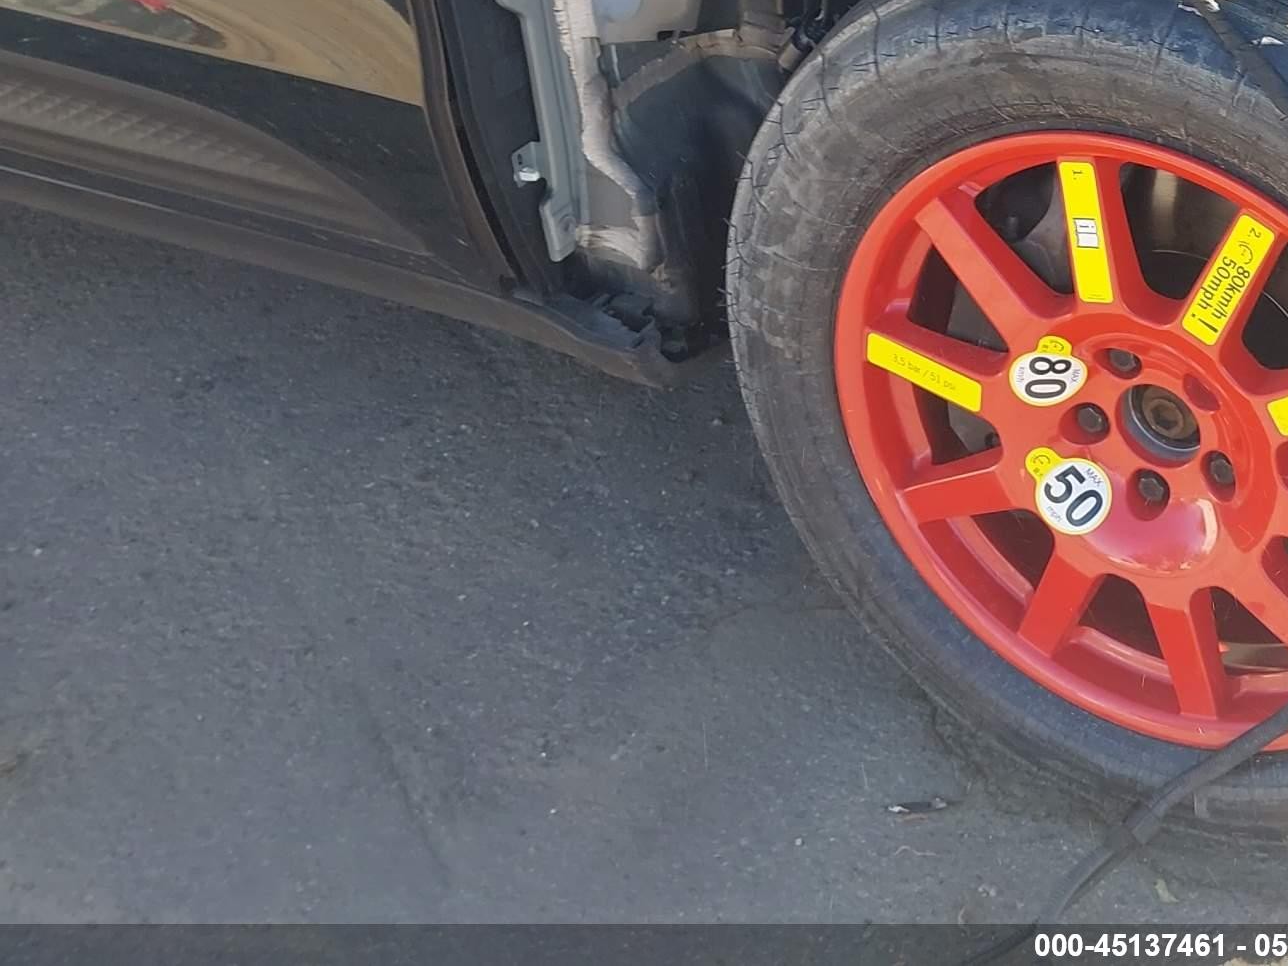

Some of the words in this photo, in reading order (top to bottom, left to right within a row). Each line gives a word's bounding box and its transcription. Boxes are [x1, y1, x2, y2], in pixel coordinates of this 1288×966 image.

[1197, 255, 1237, 310] 50mph
[1211, 265, 1251, 319] 80km/h
[1025, 356, 1073, 399] 80
[1044, 465, 1103, 527] 50
[1085, 466, 1104, 488] MAX
[1046, 505, 1063, 523] mph
